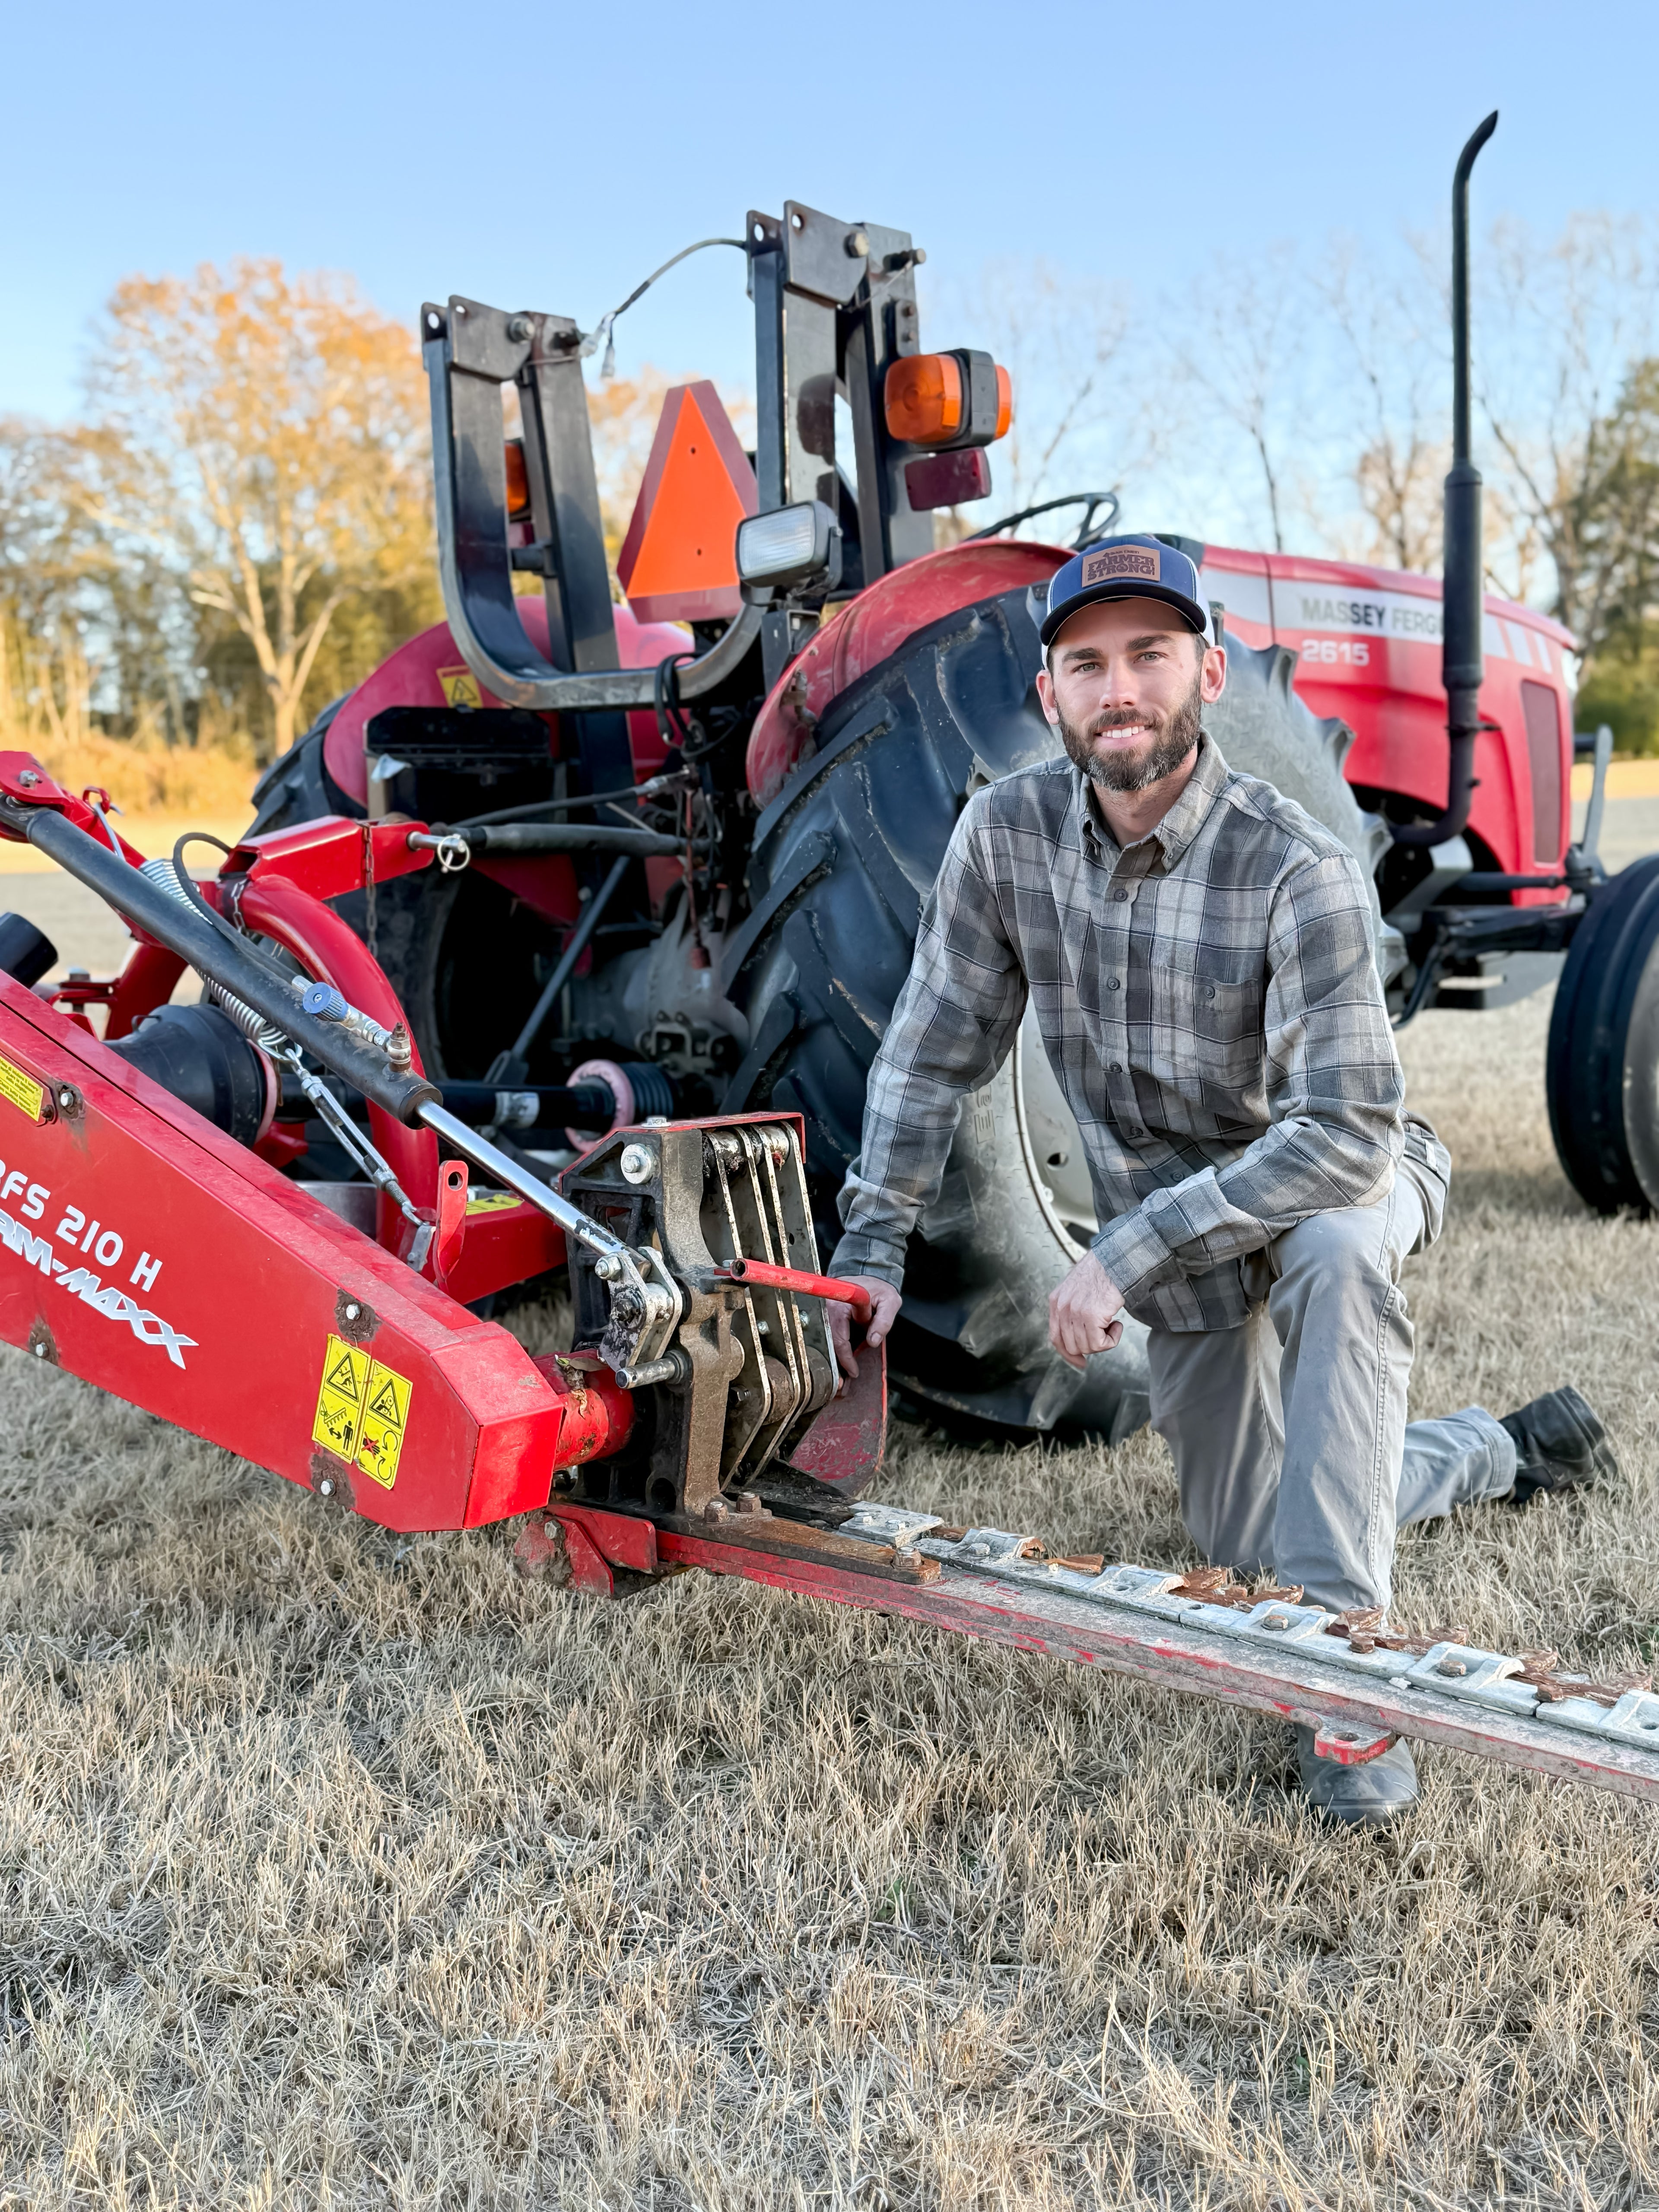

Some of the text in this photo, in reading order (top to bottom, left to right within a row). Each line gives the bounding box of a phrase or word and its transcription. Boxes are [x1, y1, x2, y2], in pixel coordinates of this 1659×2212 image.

[1088, 553, 1155, 572] FARMER
[1301, 598, 1443, 636] MASSEY FERG
[1301, 639, 1370, 666] 2615
[56, 1205, 124, 1266] 210
[130, 1252, 162, 1292] H
